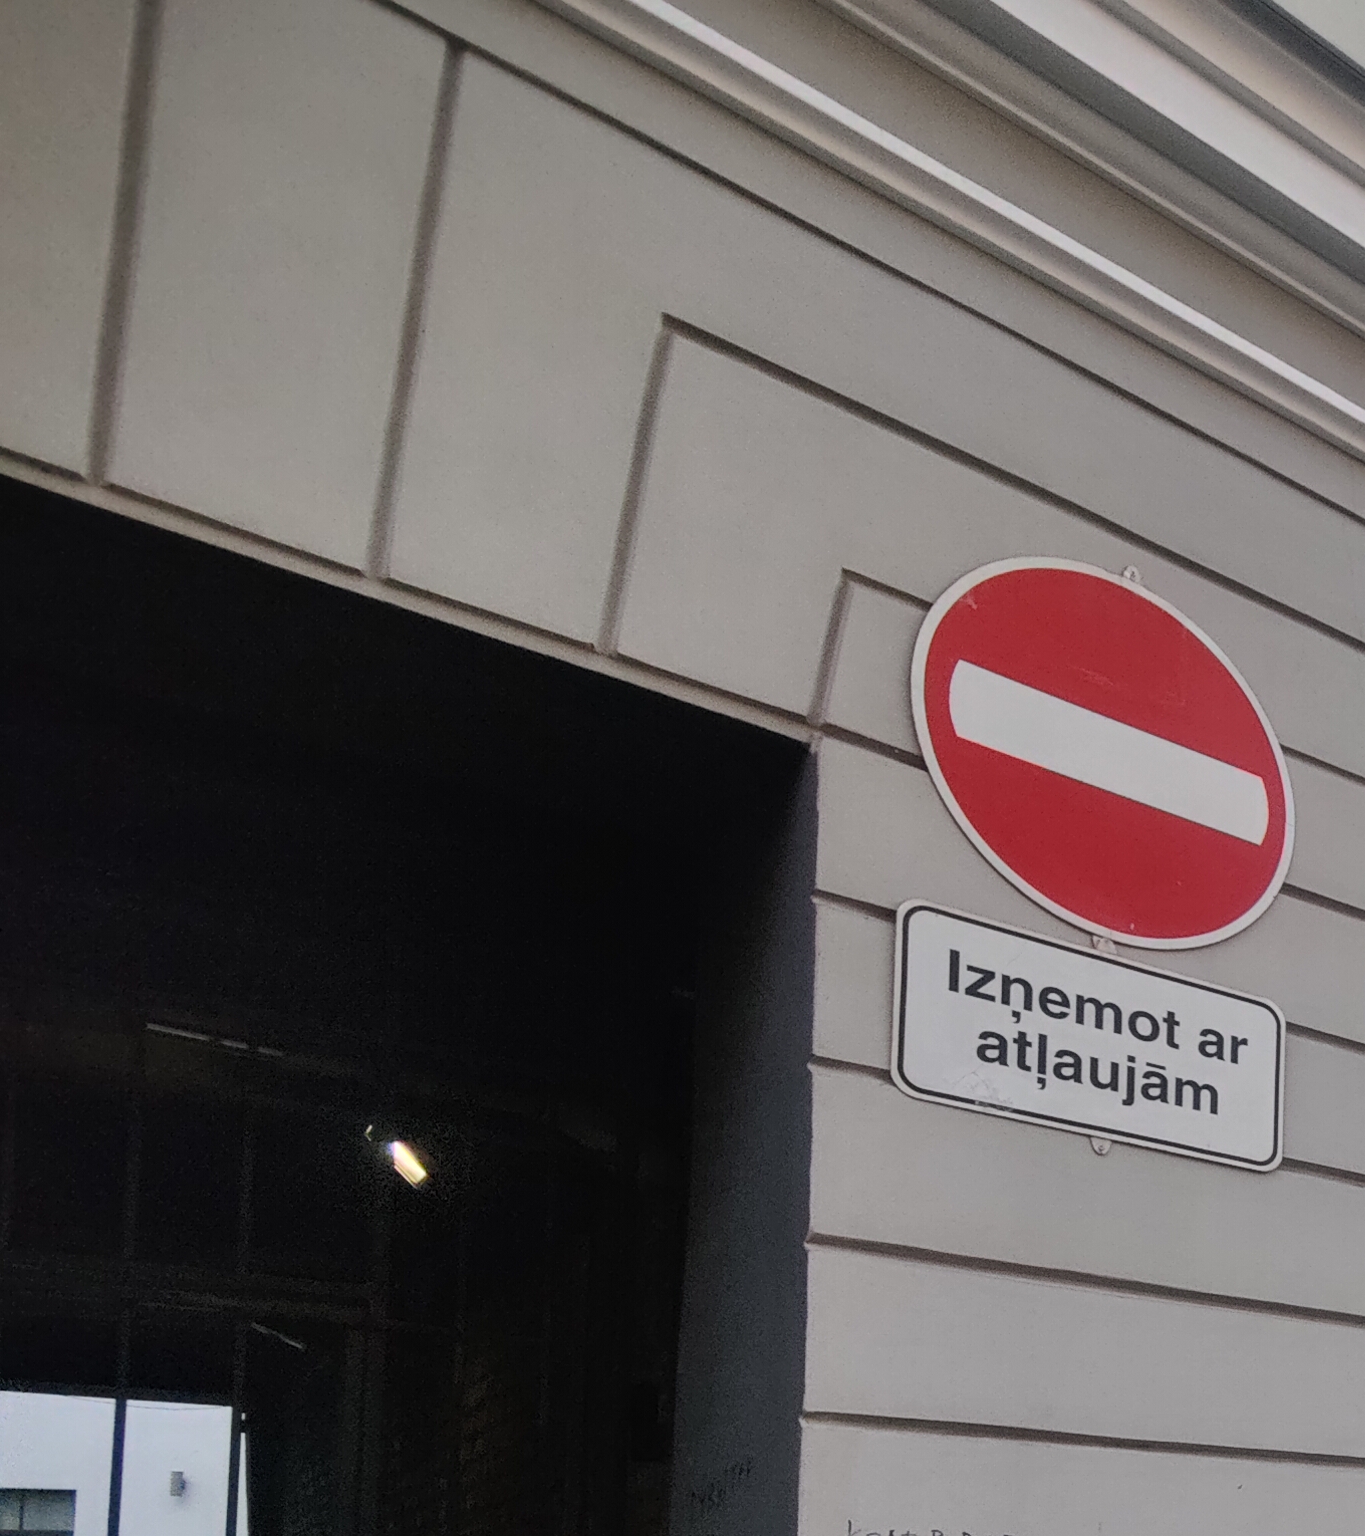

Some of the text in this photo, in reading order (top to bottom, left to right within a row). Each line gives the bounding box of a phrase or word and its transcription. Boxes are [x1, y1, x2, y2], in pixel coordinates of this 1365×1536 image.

[948, 948, 1249, 1065] Izņemot ar
[976, 1029, 1220, 1116] atļaujām
